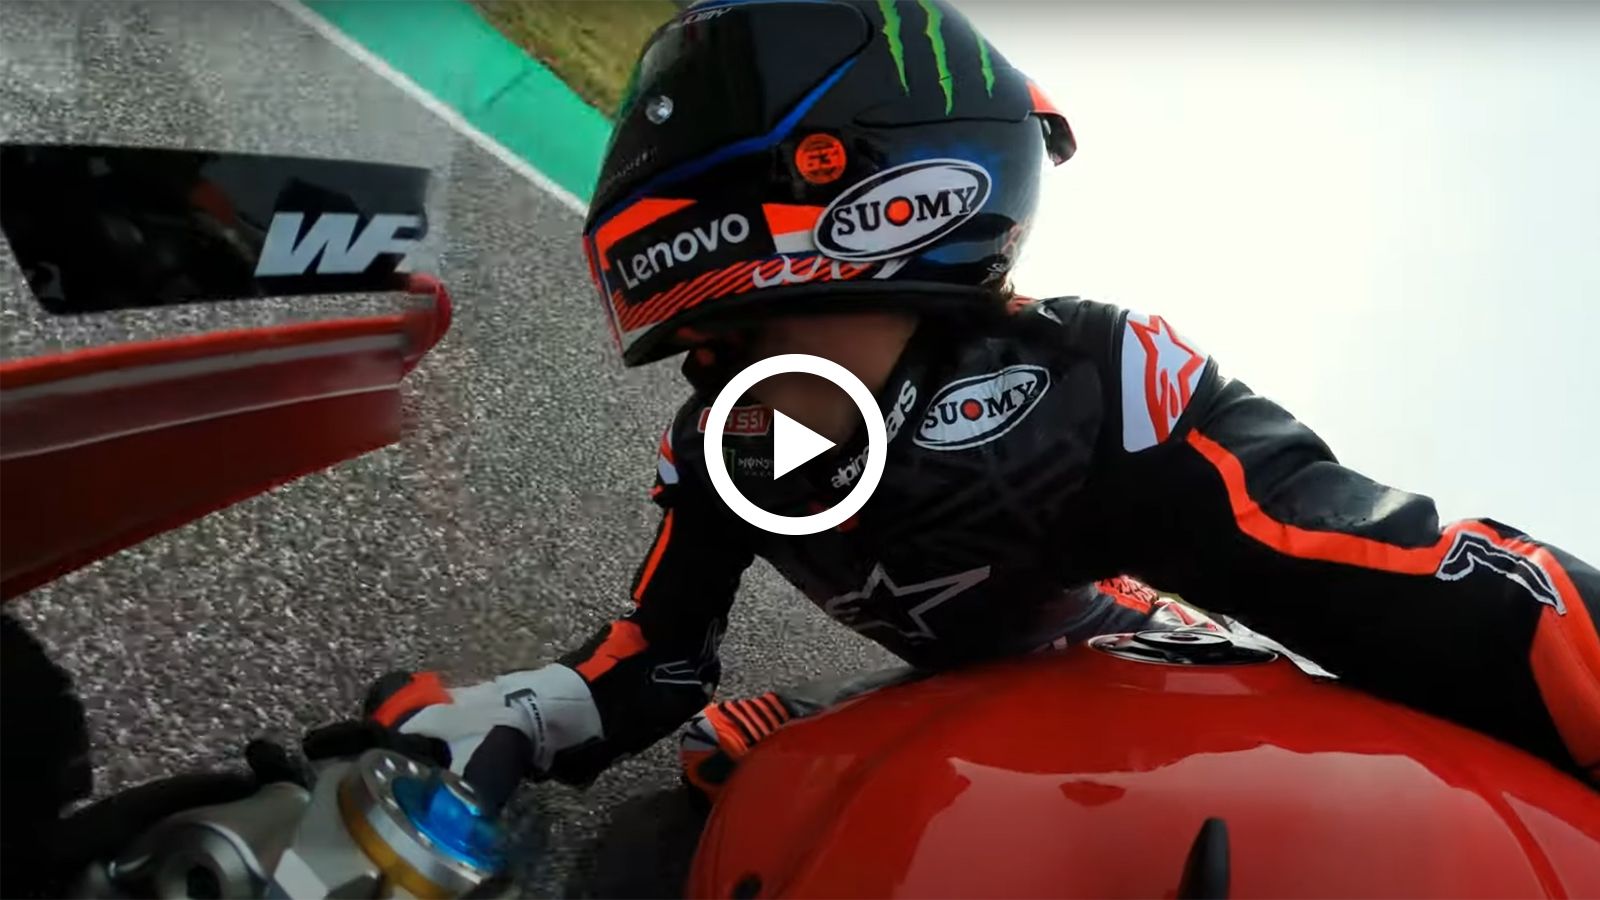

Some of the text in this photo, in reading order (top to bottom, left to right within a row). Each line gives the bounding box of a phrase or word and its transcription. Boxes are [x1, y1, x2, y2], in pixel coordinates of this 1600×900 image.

[834, 186, 976, 237] SUOMY
[617, 213, 750, 290] Lenovo
[925, 381, 1035, 429] SUOMY
[738, 456, 774, 469] MONS
